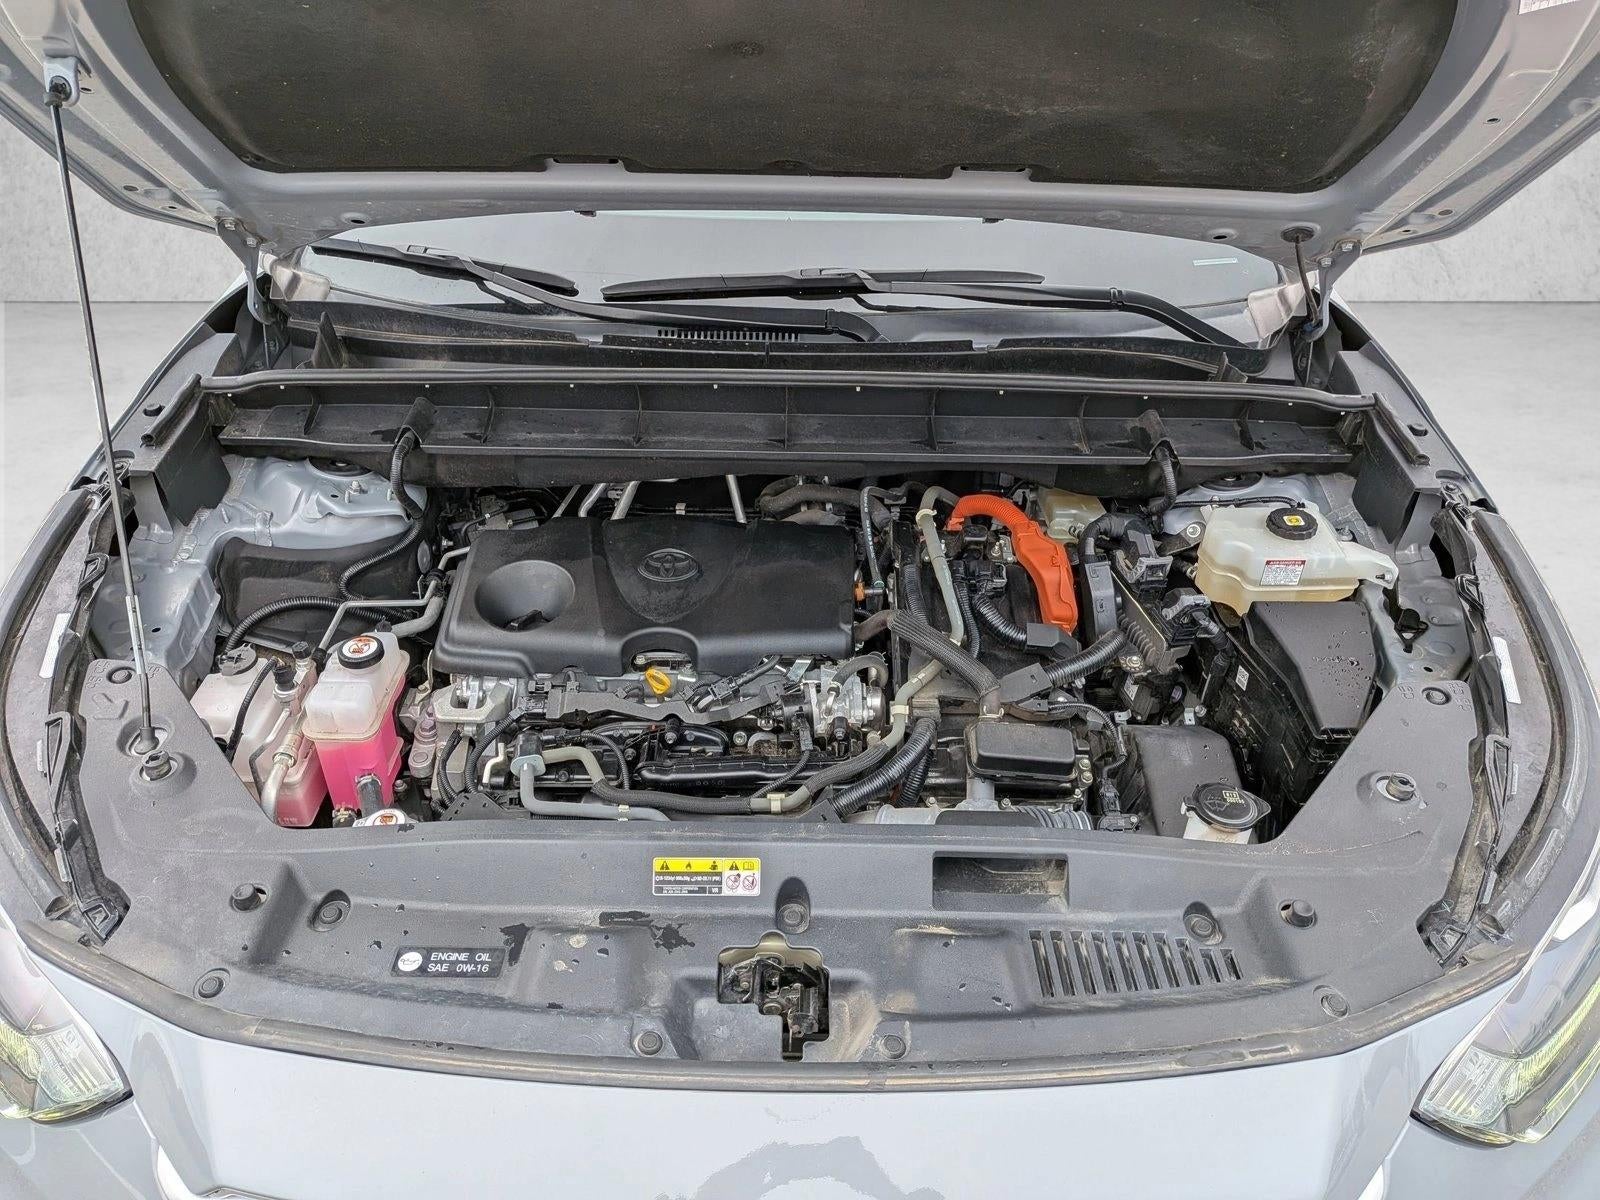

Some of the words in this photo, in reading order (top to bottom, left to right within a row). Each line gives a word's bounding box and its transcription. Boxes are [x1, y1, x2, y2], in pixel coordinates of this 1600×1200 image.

[430, 952, 469, 961] ENGINE
[475, 952, 492, 962] OIL
[427, 963, 450, 972] SAE
[456, 963, 489, 973] 0W-16
